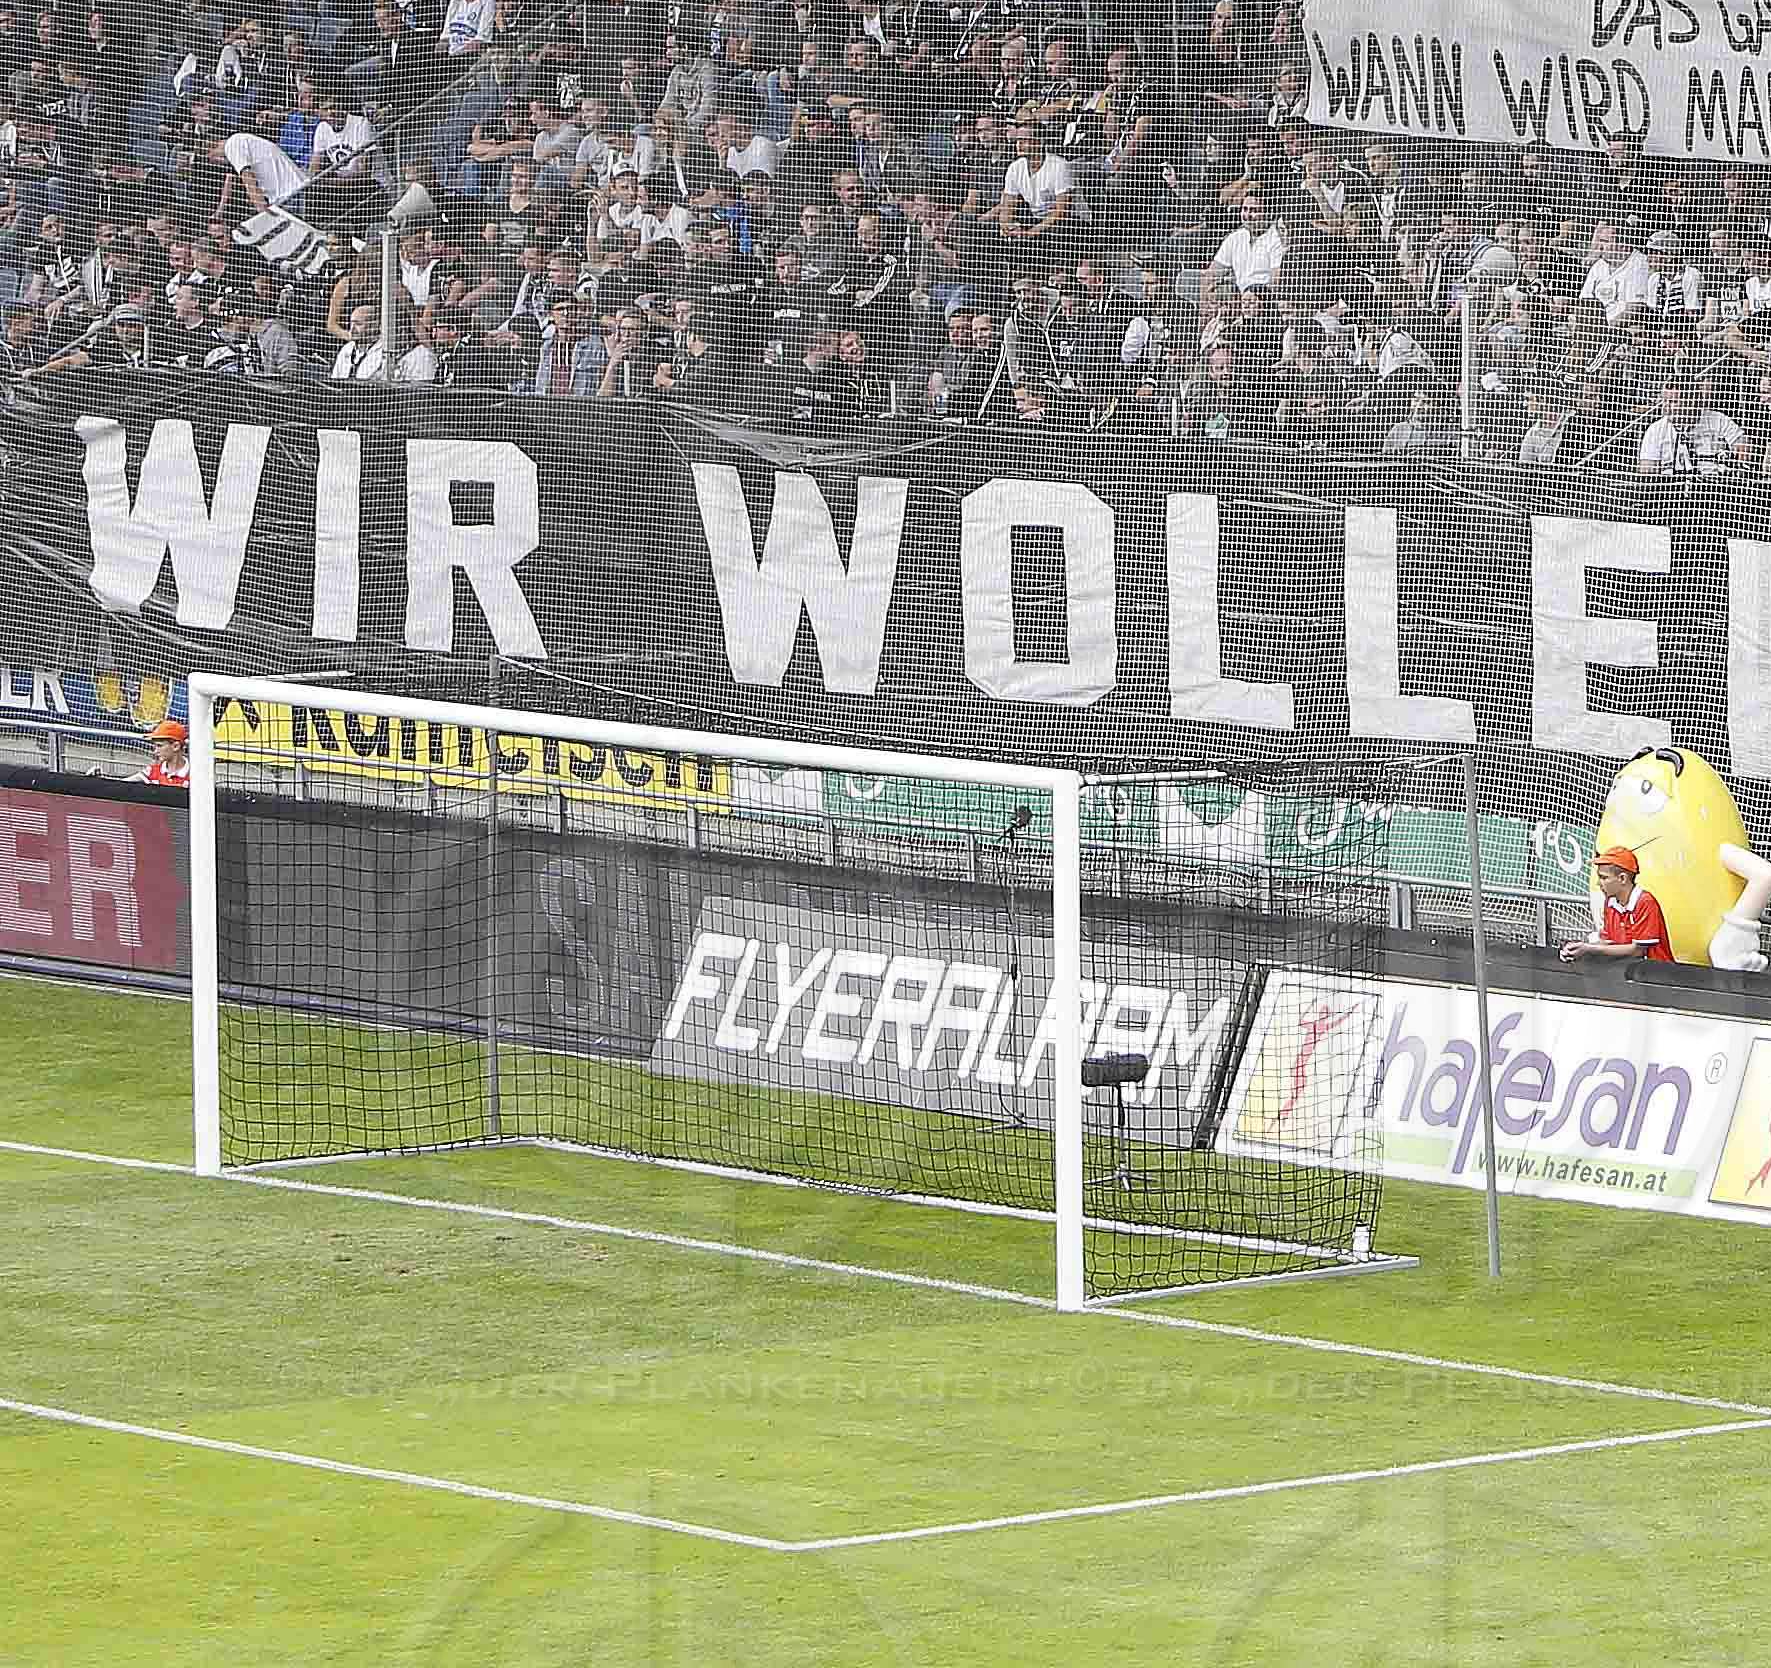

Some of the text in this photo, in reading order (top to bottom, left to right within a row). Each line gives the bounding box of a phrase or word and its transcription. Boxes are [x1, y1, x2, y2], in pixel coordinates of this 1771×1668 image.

[1311, 31, 1467, 136] WANN
[1493, 46, 1651, 146] WIRD
[74, 415, 549, 659] WIR
[1381, 1001, 1692, 1174] hafesan
